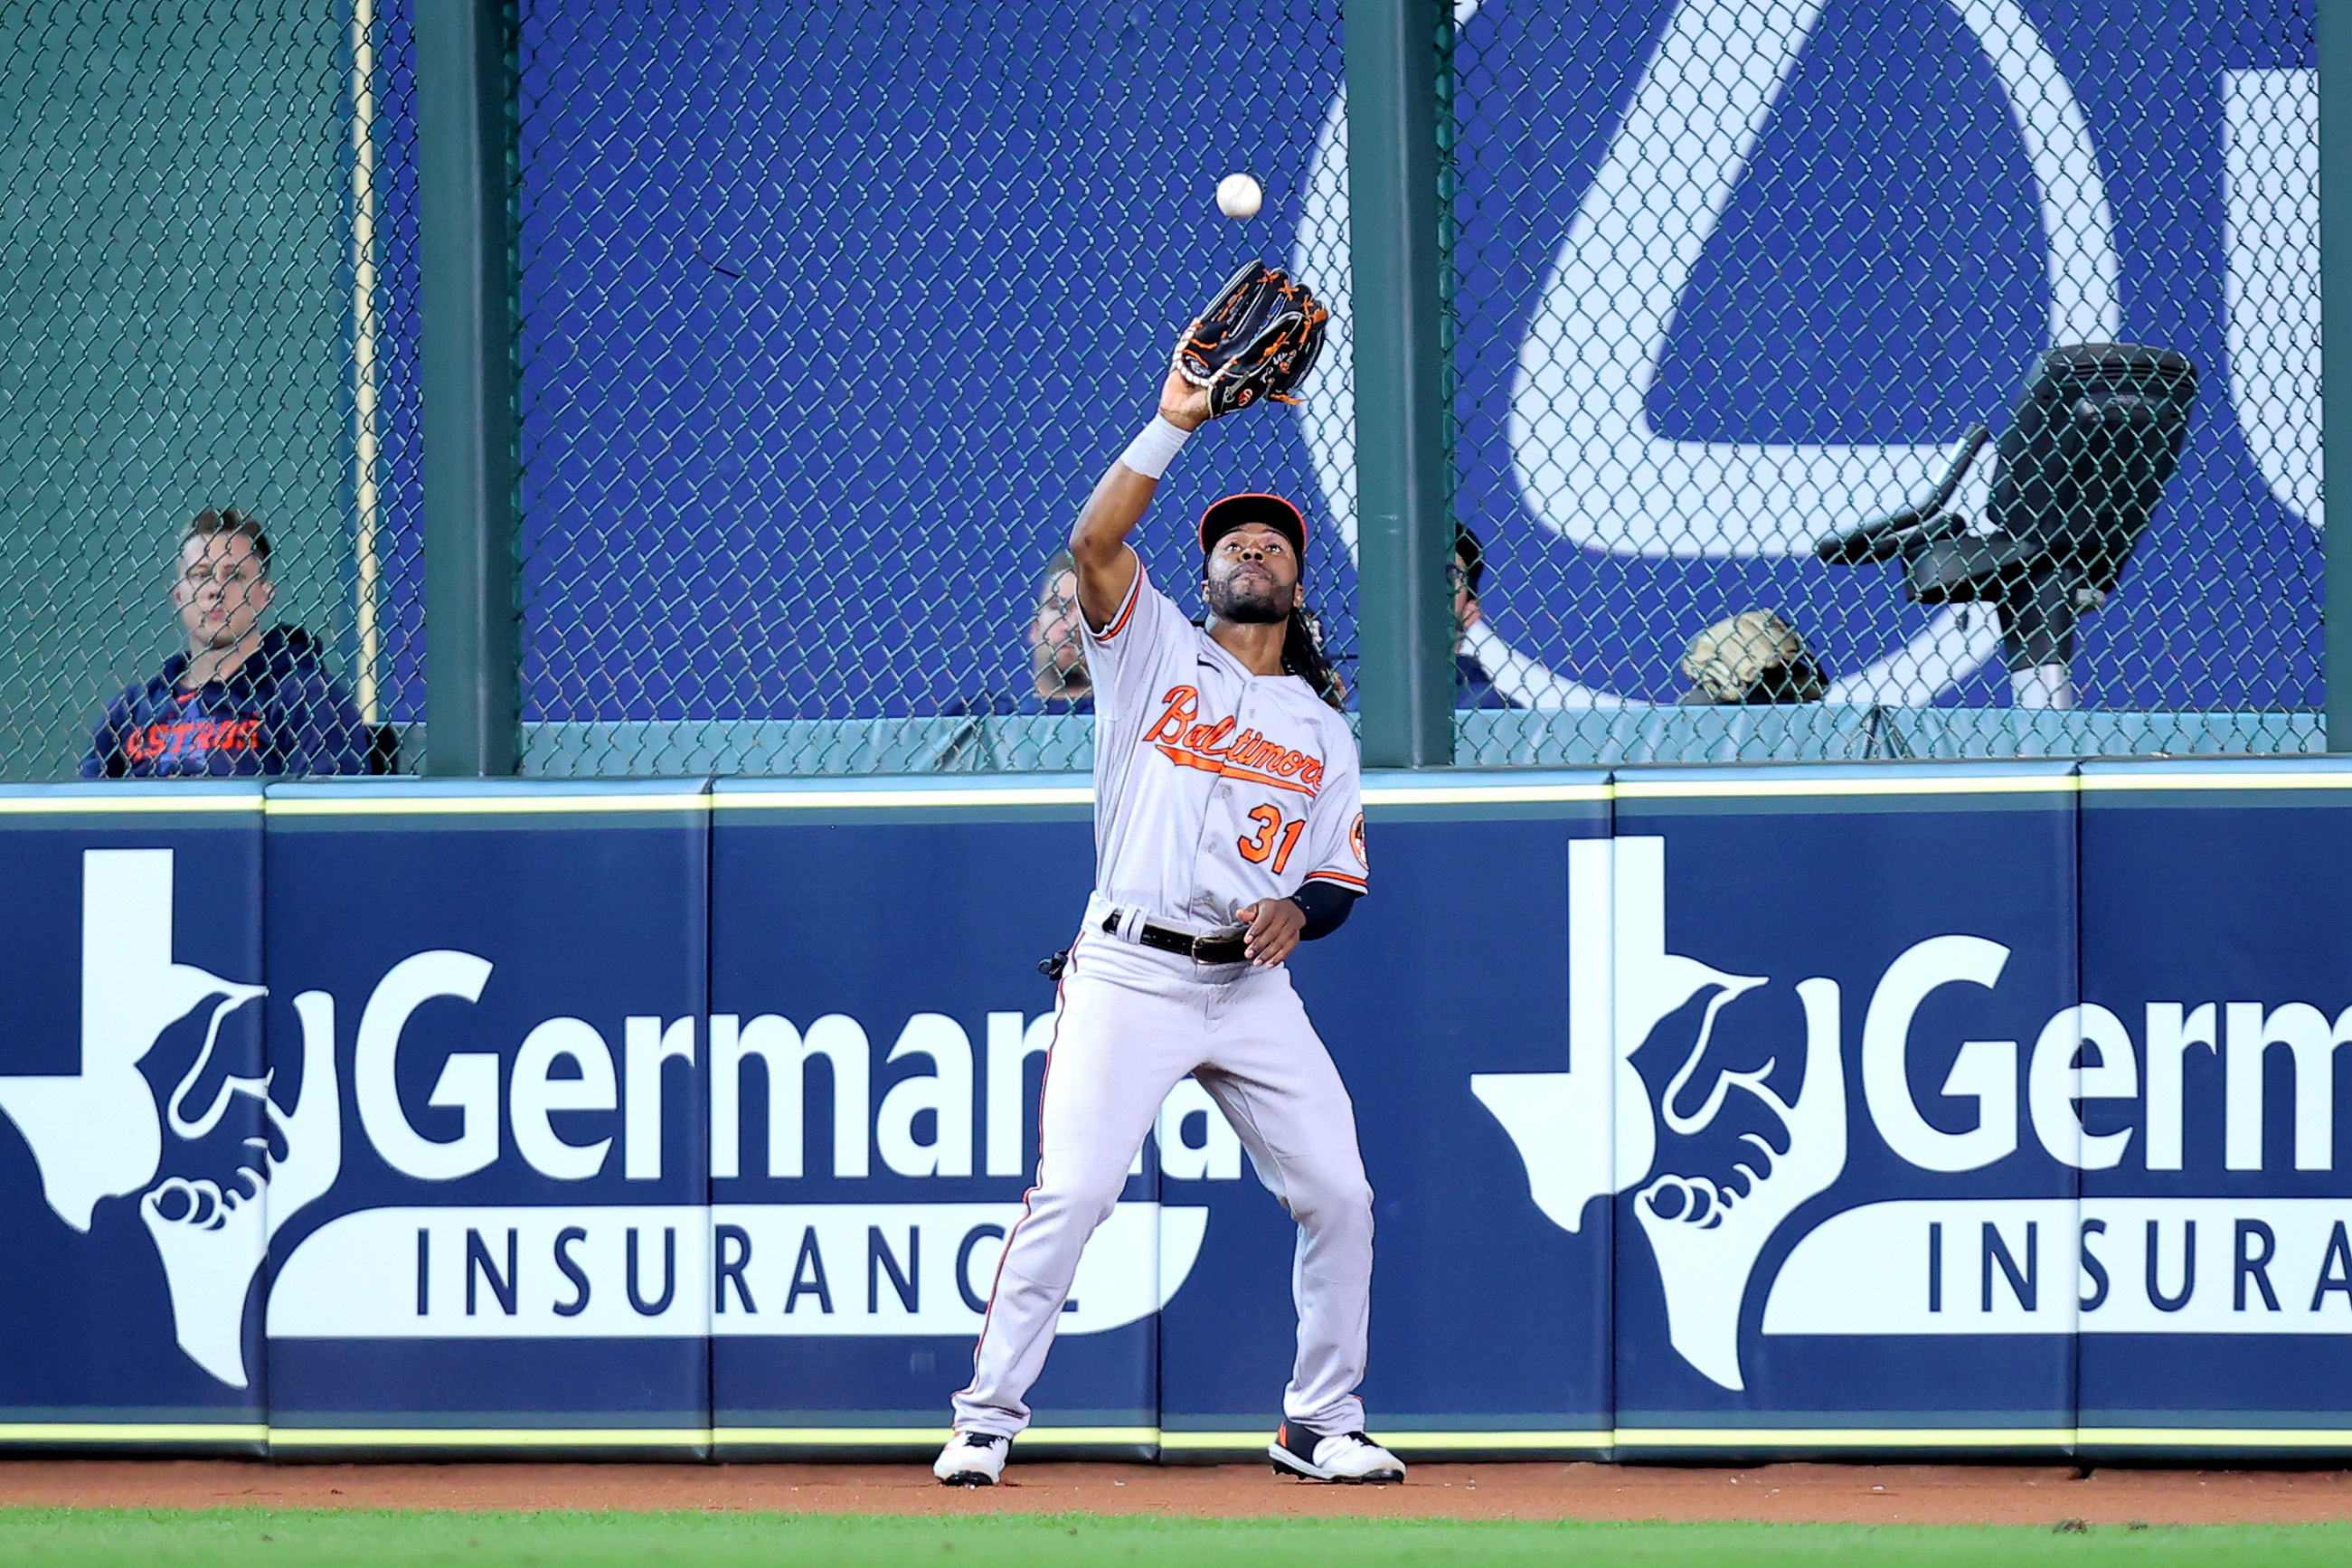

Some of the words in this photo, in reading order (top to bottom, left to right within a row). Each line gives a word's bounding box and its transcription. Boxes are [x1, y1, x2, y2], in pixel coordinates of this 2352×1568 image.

[1237, 803, 1307, 876] 31
[354, 949, 1242, 1179] Germana
[416, 1223, 1078, 1317] INSURANC
